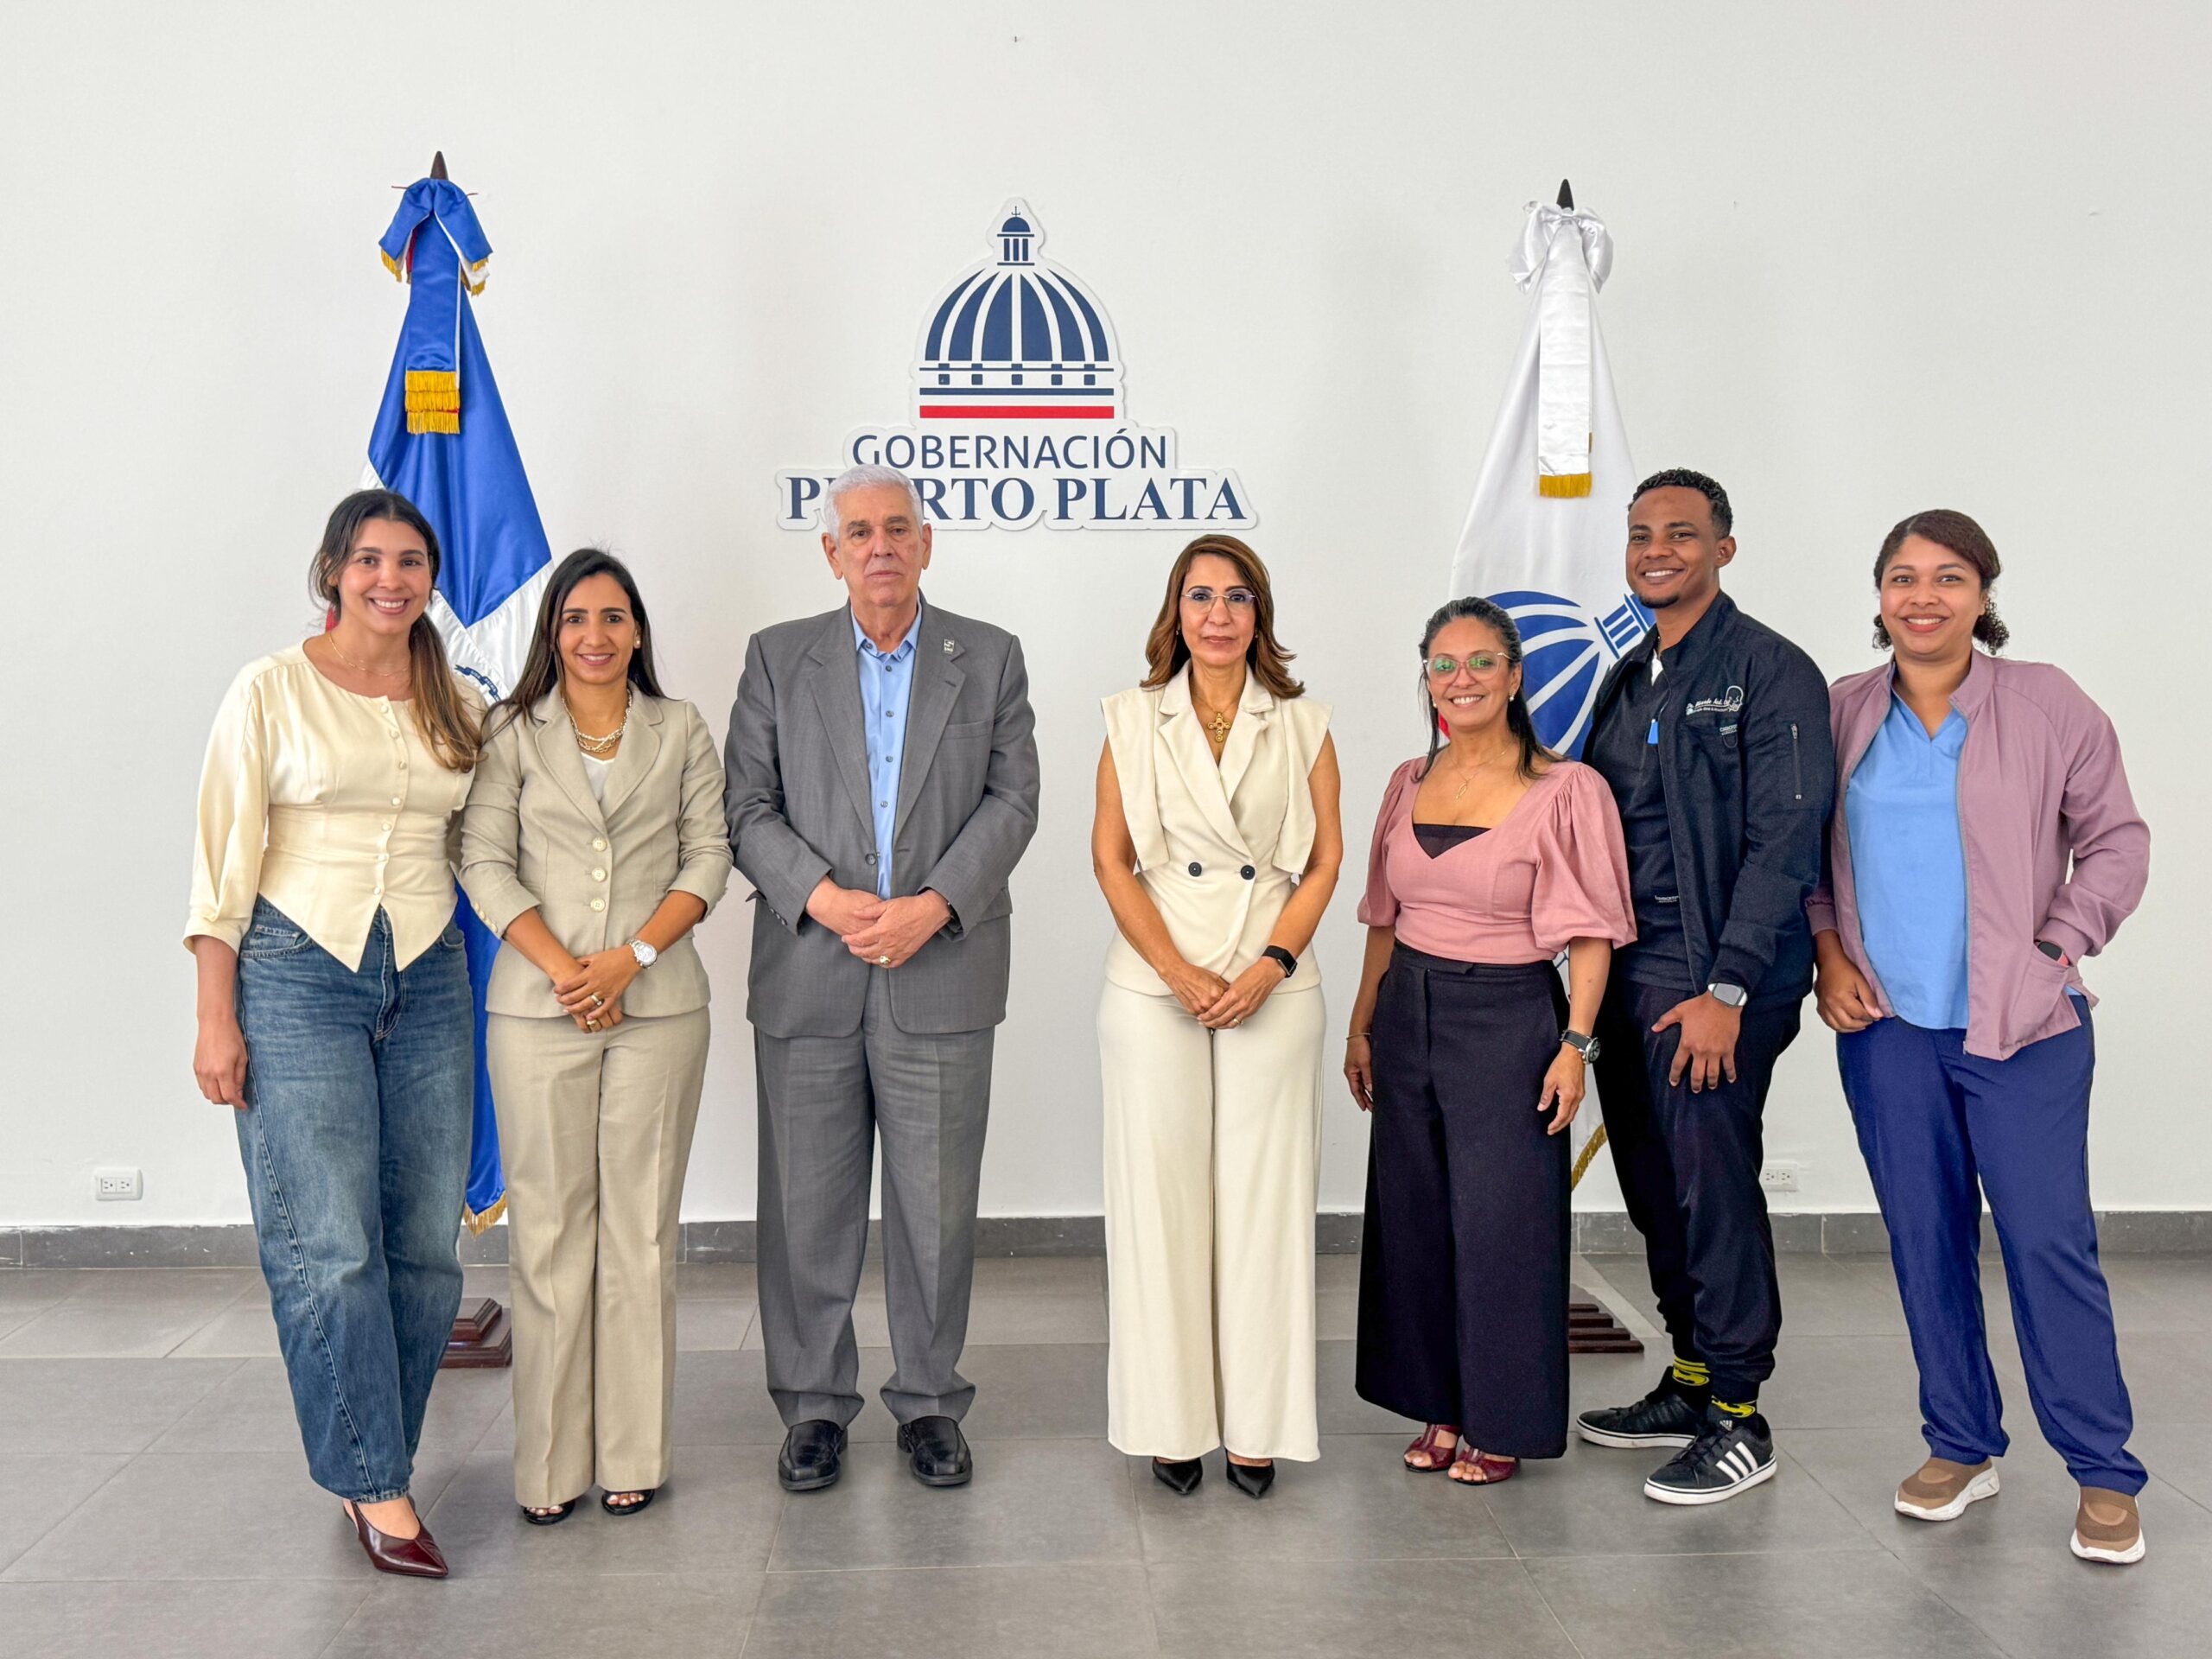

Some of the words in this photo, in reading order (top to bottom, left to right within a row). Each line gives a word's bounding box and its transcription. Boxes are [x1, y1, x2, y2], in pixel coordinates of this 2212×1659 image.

[852, 429, 1166, 469] GOBERNACIÓN
[785, 476, 1036, 521] PRTO
[1052, 476, 1248, 521] PLATA
